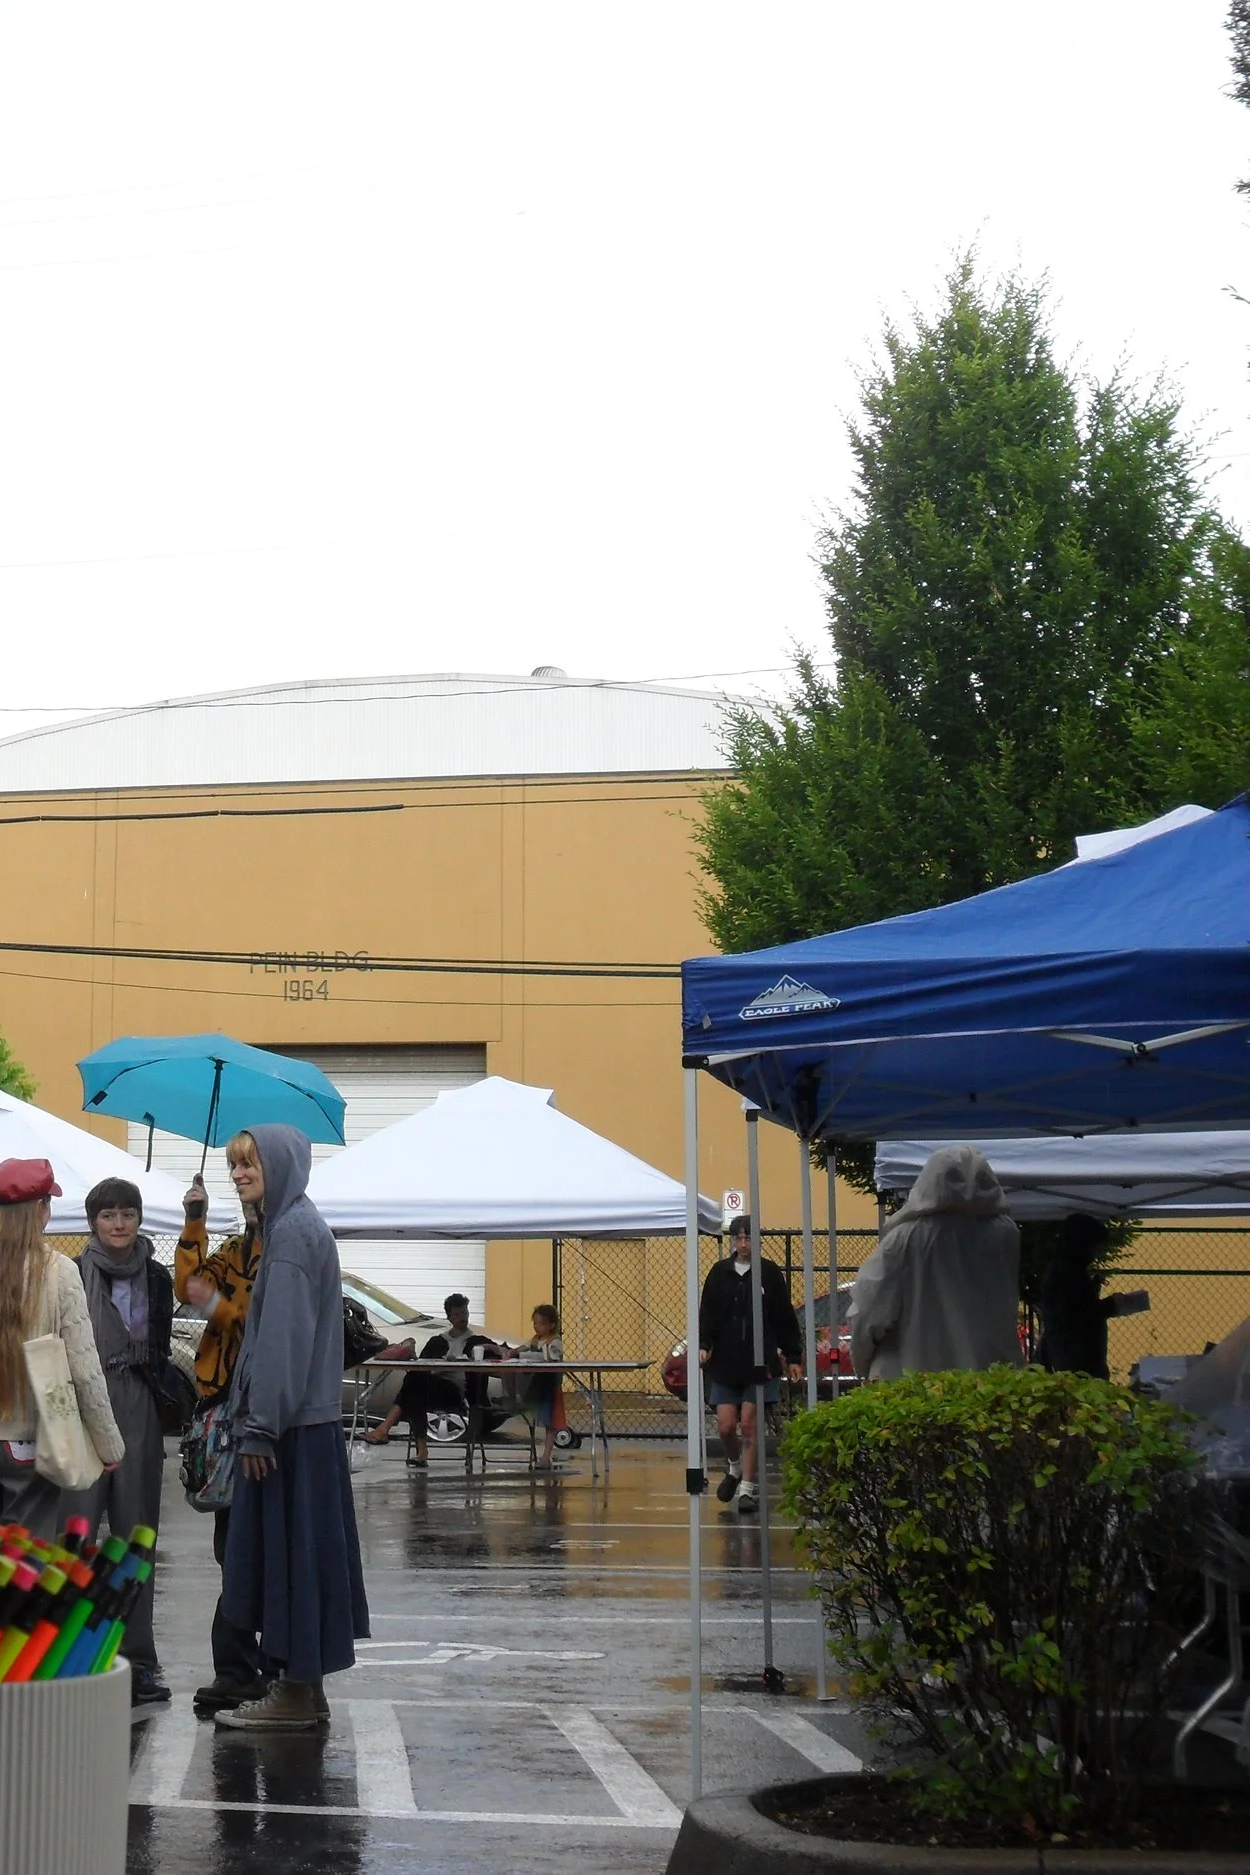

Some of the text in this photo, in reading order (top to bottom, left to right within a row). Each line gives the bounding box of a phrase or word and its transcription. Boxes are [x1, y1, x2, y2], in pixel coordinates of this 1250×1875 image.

[283, 979, 330, 1002] 1964
[744, 1000, 834, 1017] EAGLE PEAK
